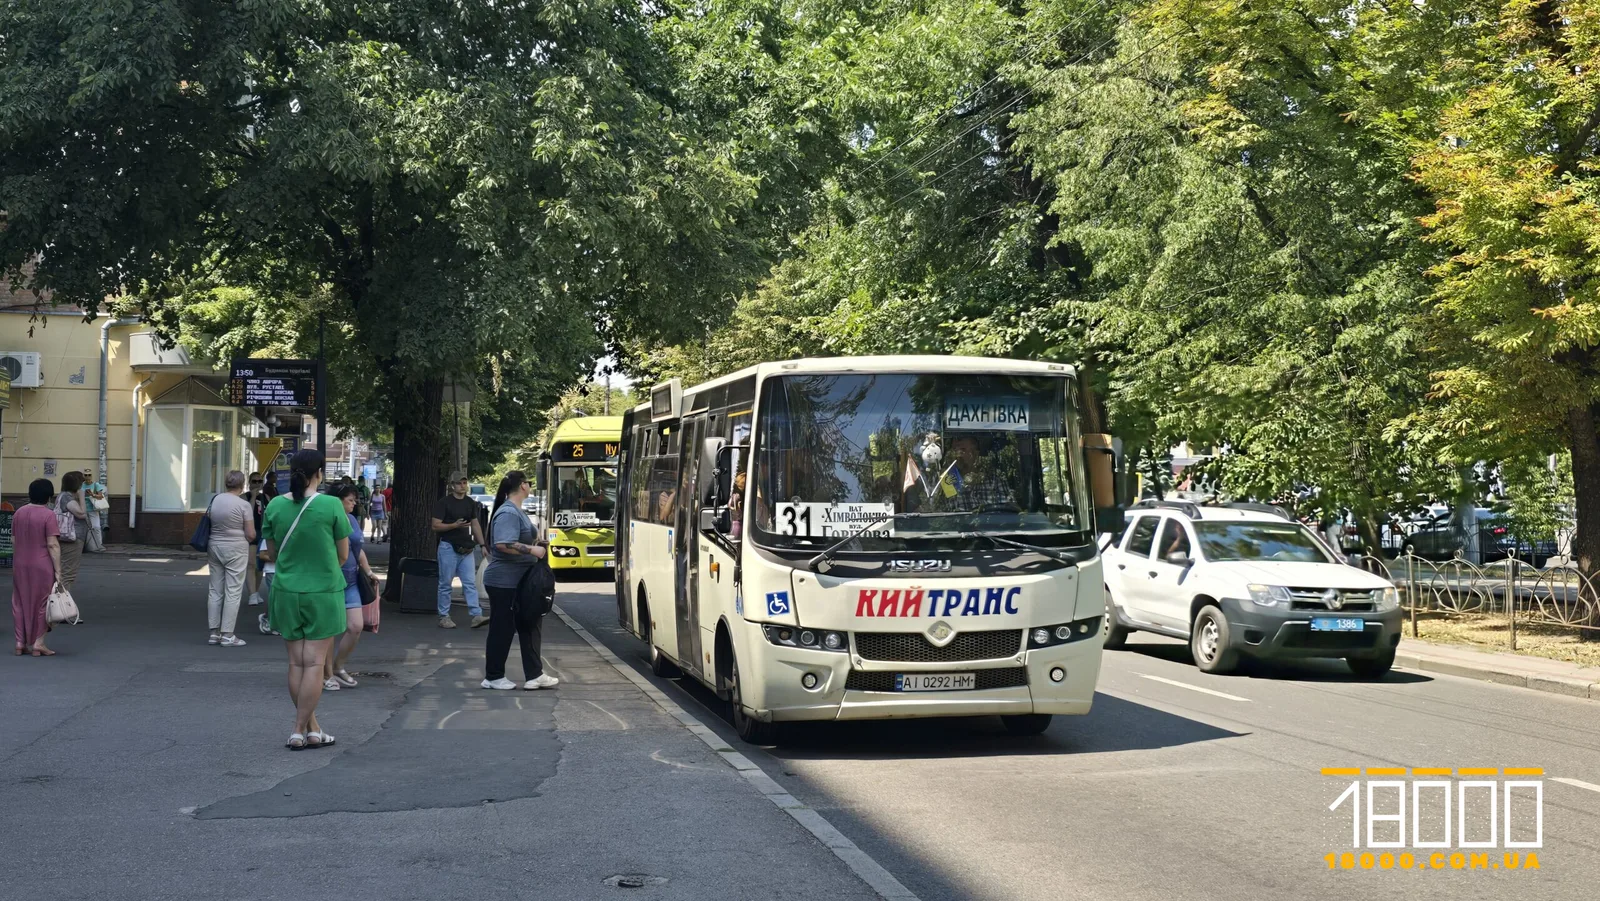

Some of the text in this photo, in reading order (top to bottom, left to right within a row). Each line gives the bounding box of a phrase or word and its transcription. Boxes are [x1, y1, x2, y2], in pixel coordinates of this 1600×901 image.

[948, 403, 1028, 426] ДАХНІВКА
[572, 443, 620, 457] 25 Ny
[556, 514, 568, 526] 25
[782, 506, 812, 537] 31
[891, 560, 952, 572] ISUZU
[1336, 619, 1356, 628] 1386
[924, 676, 950, 688] 0292
